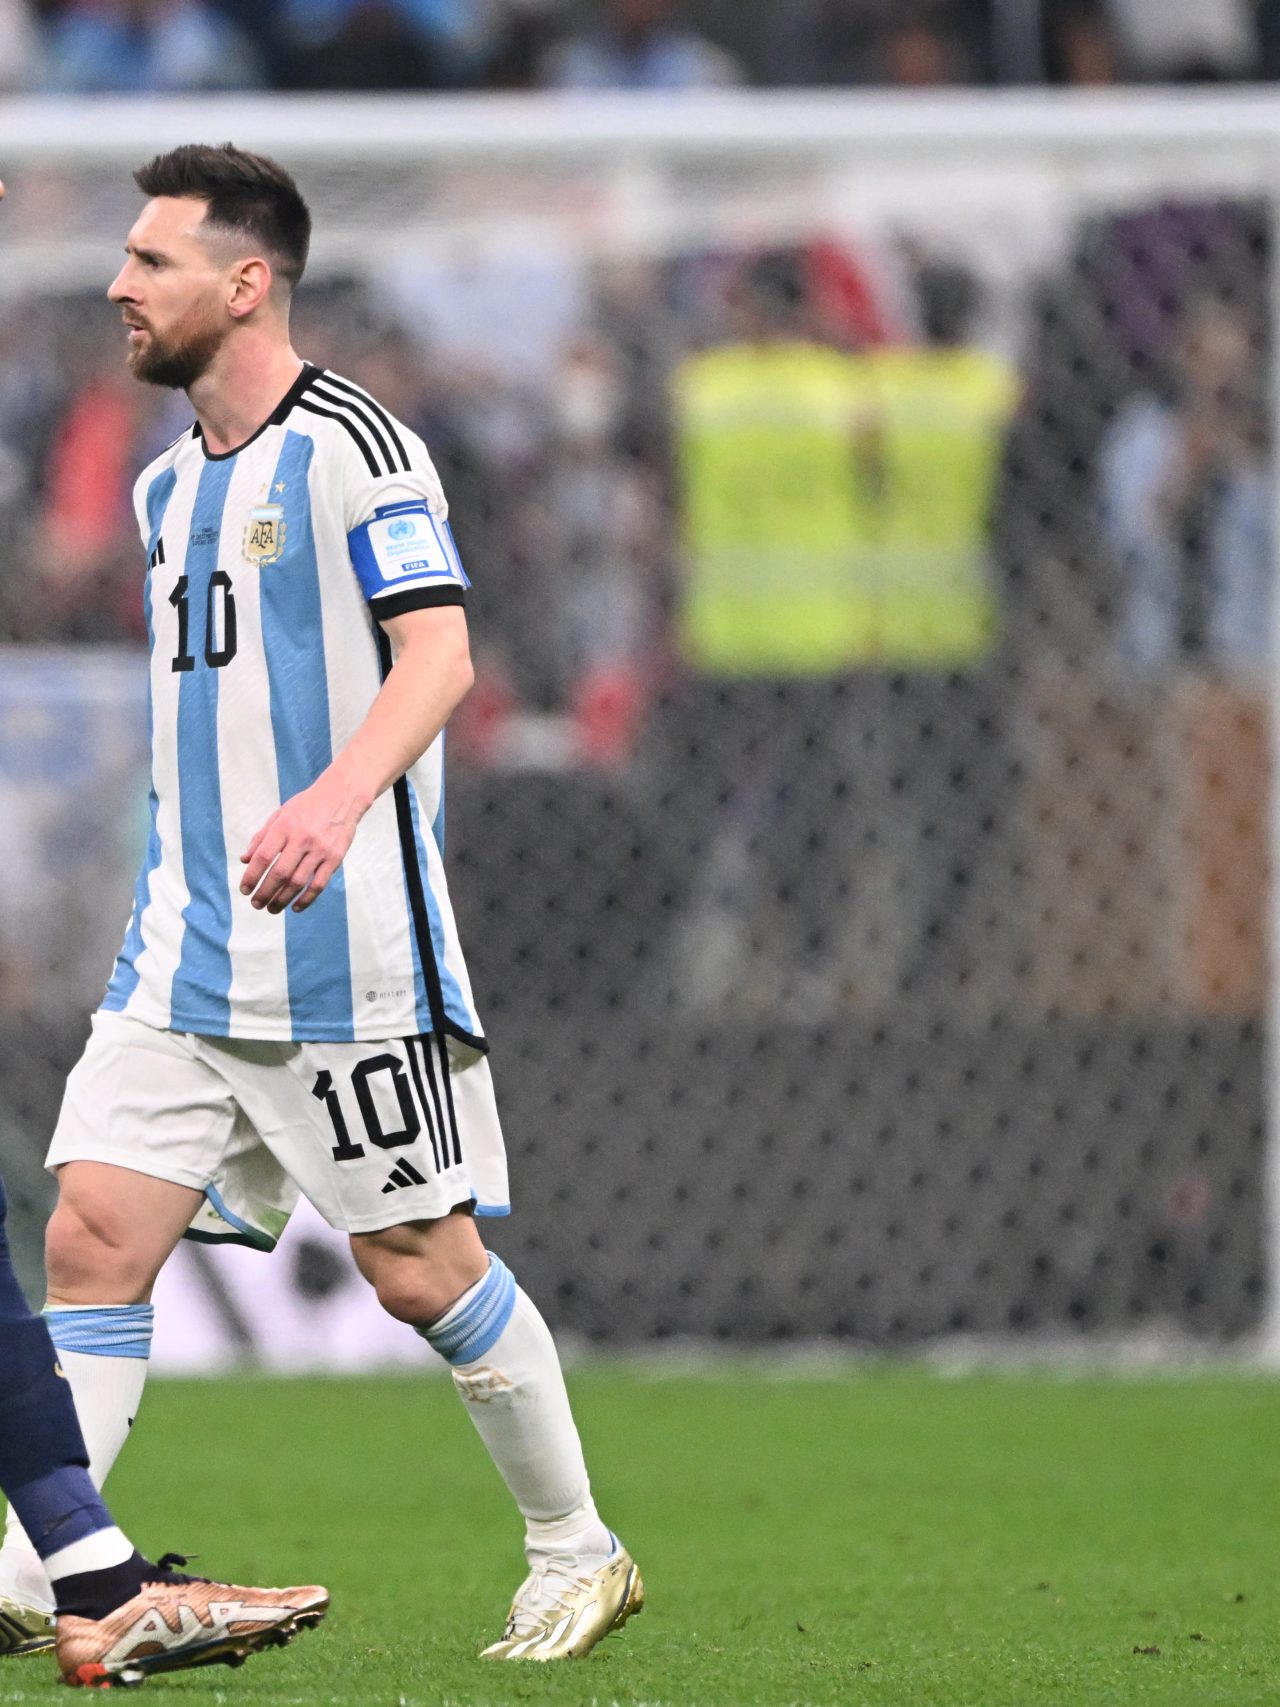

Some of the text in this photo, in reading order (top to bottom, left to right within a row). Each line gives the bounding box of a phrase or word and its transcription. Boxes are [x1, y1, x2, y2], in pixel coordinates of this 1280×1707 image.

[250, 520, 274, 549] AFA
[404, 560, 426, 571] FIFA
[168, 570, 238, 673] 10
[311, 1052, 422, 1162] 10
